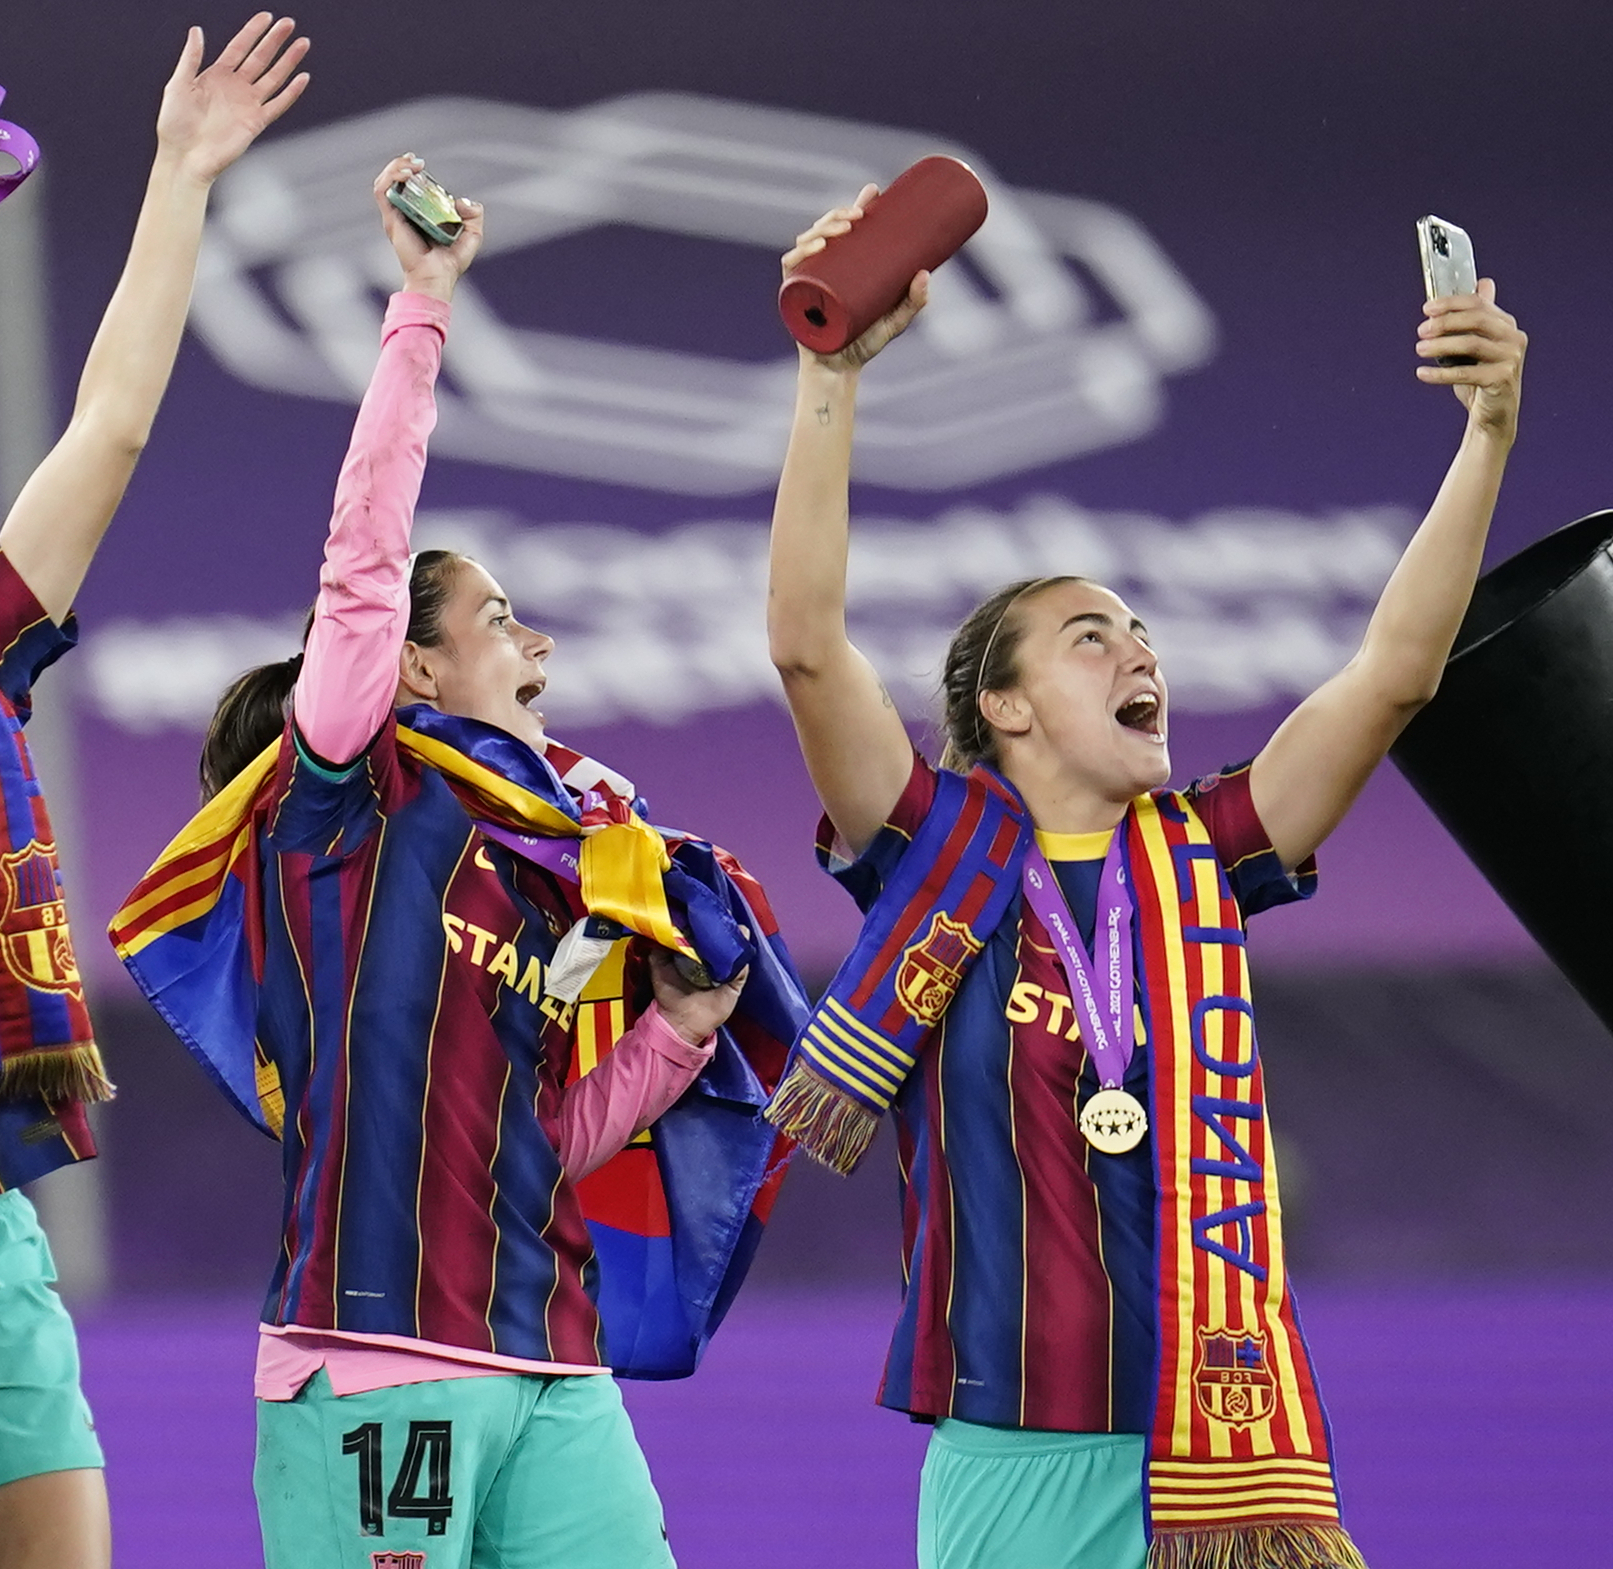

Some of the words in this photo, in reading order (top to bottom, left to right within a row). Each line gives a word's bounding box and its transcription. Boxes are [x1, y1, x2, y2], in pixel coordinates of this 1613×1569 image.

[1048, 913, 1071, 945] FINAL
[1066, 944, 1083, 969] 2021
[1076, 968, 1109, 1050] GOTHENBURG
[1108, 906, 1122, 989] GOTHENBURG
[1109, 989, 1122, 1015] 2021
[342, 1420, 453, 1537] 14
